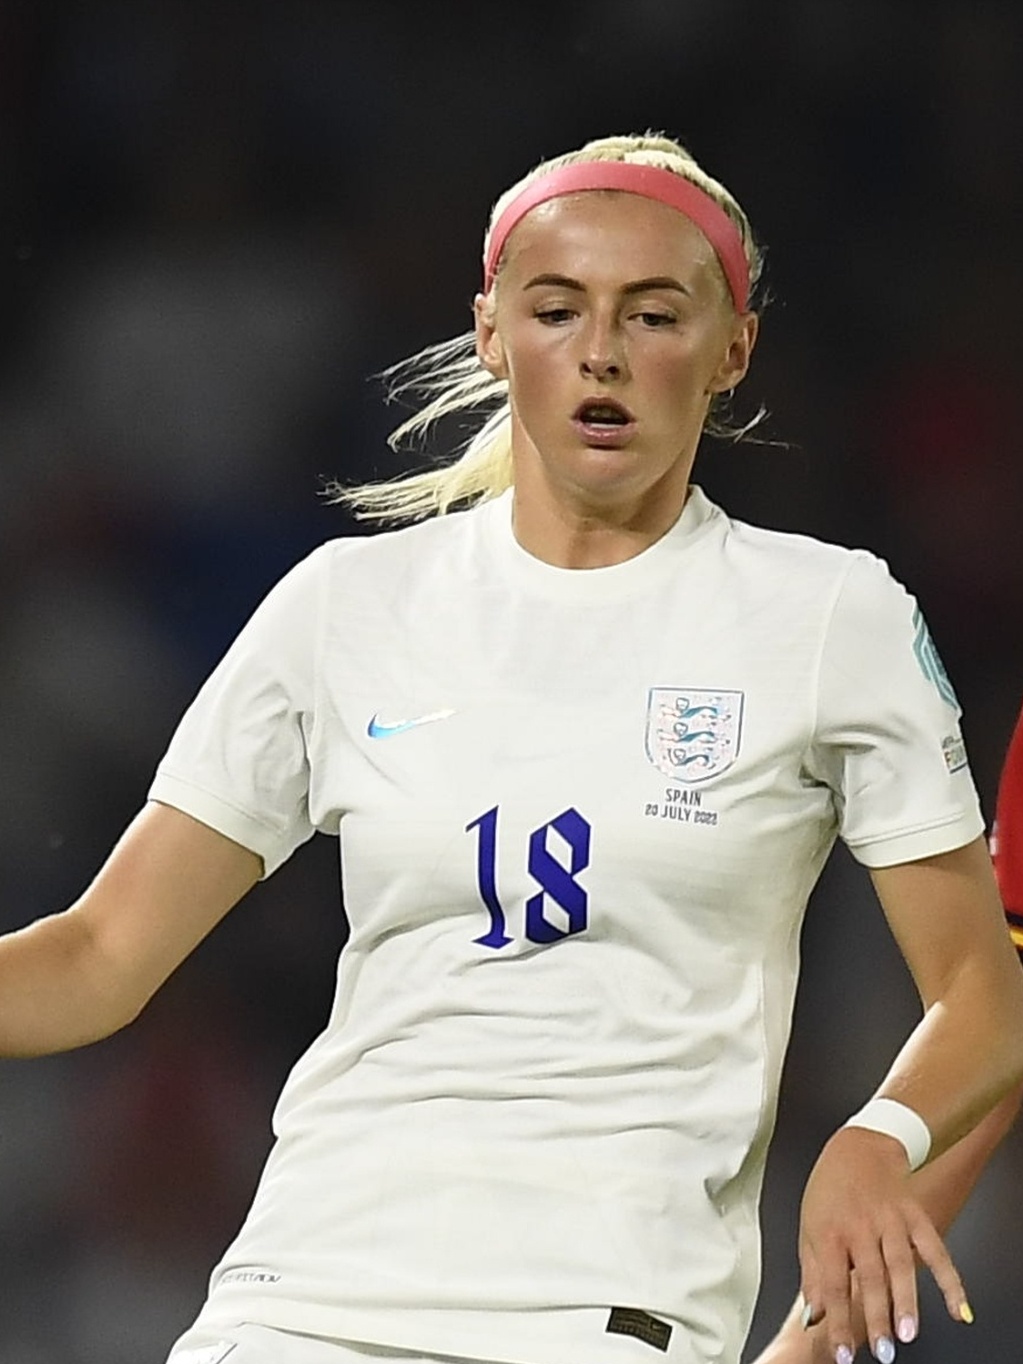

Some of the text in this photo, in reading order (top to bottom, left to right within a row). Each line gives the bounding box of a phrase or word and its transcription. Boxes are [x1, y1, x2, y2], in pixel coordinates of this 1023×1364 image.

[665, 788, 702, 807] SPAIN
[661, 805, 691, 822] JULY
[466, 804, 592, 950] 18
